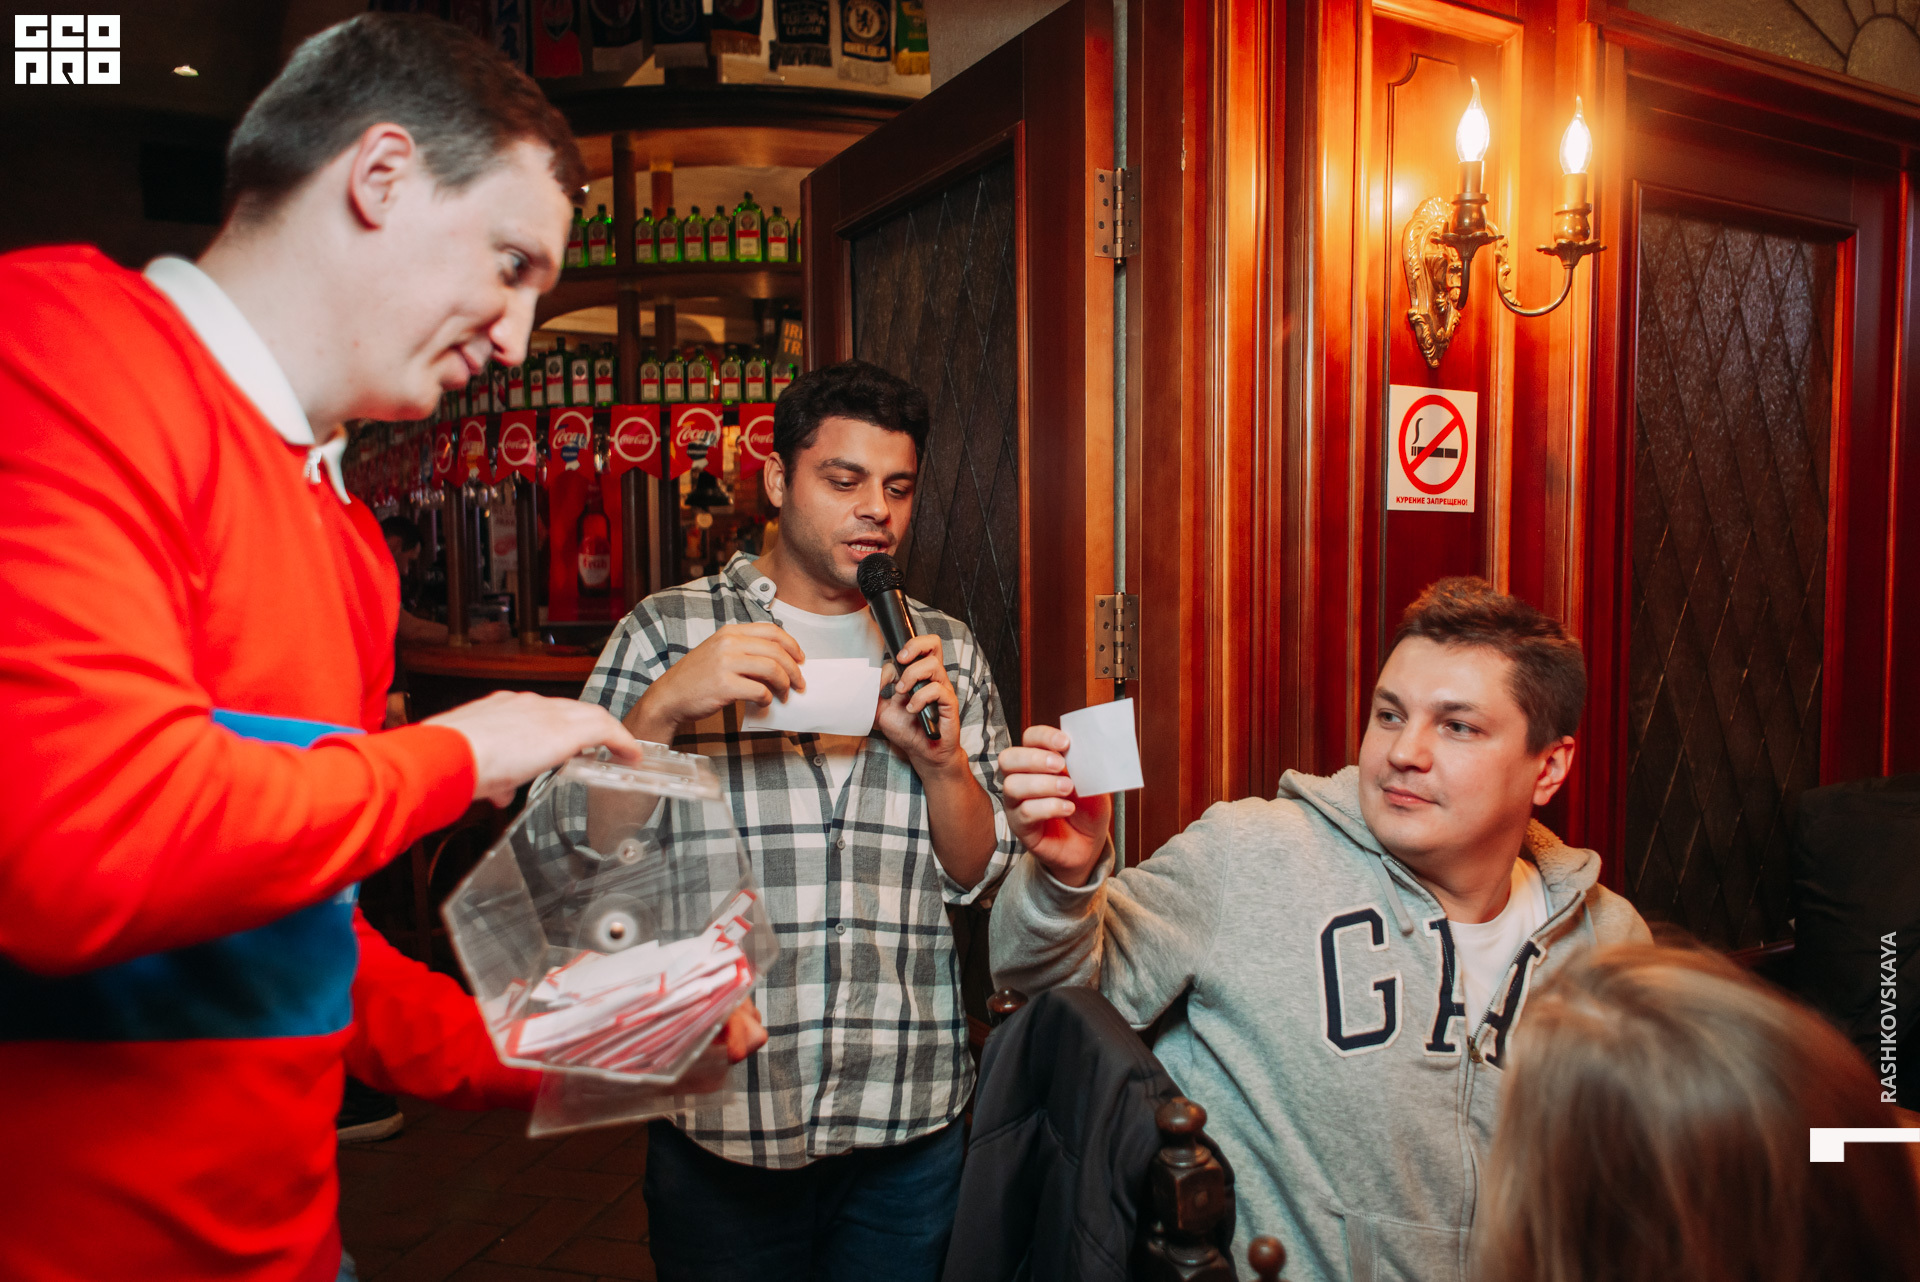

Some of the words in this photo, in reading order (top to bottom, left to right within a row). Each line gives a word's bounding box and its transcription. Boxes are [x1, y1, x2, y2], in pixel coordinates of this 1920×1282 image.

[783, 338, 803, 356] TR
[619, 434, 651, 446] Coca-Cola
[1396, 496, 1425, 505] КУРЕНИЕ
[1426, 497, 1468, 506] ЗАПРЕЩЕНО!
